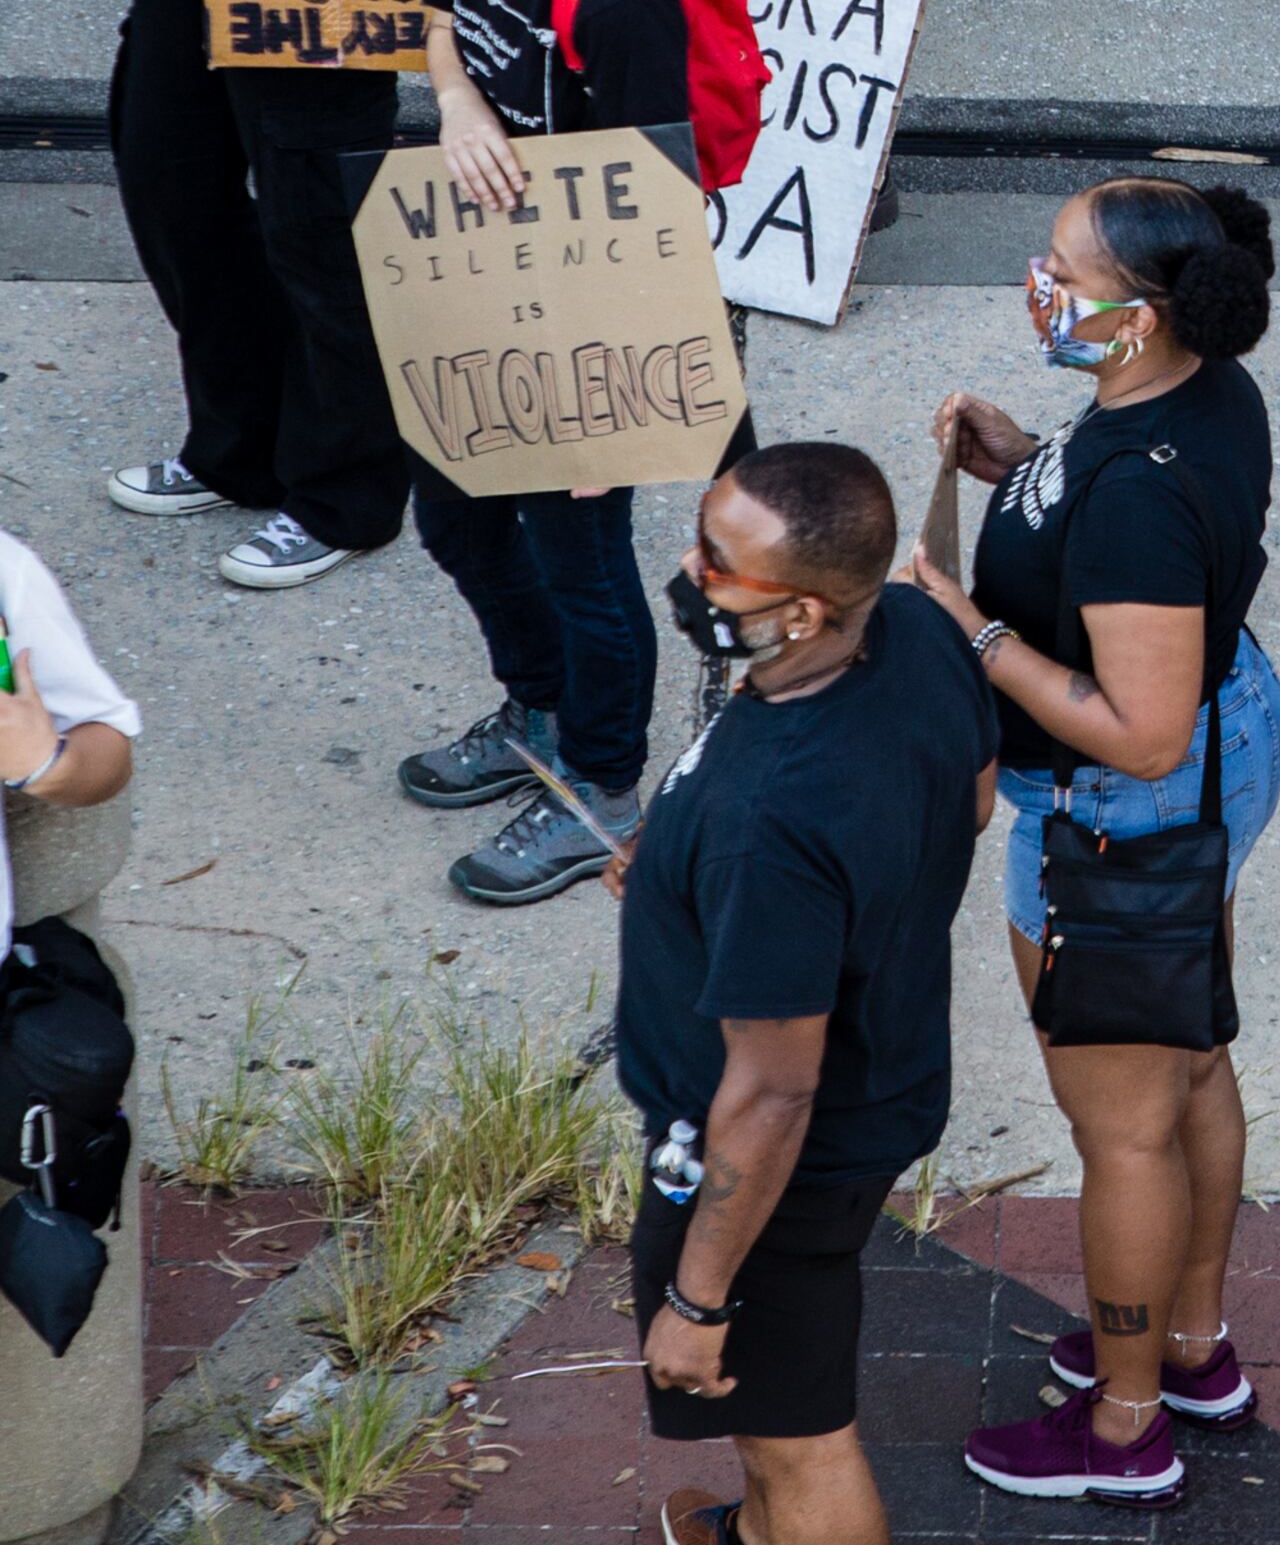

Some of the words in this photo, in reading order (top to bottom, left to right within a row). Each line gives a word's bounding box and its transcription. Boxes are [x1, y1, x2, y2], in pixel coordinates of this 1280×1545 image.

[229, 2, 338, 64] THE
[389, 161, 639, 240] WHITE
[384, 228, 678, 285] SILENCE
[513, 302, 544, 323] IS
[400, 335, 728, 462] VIOLENCE
